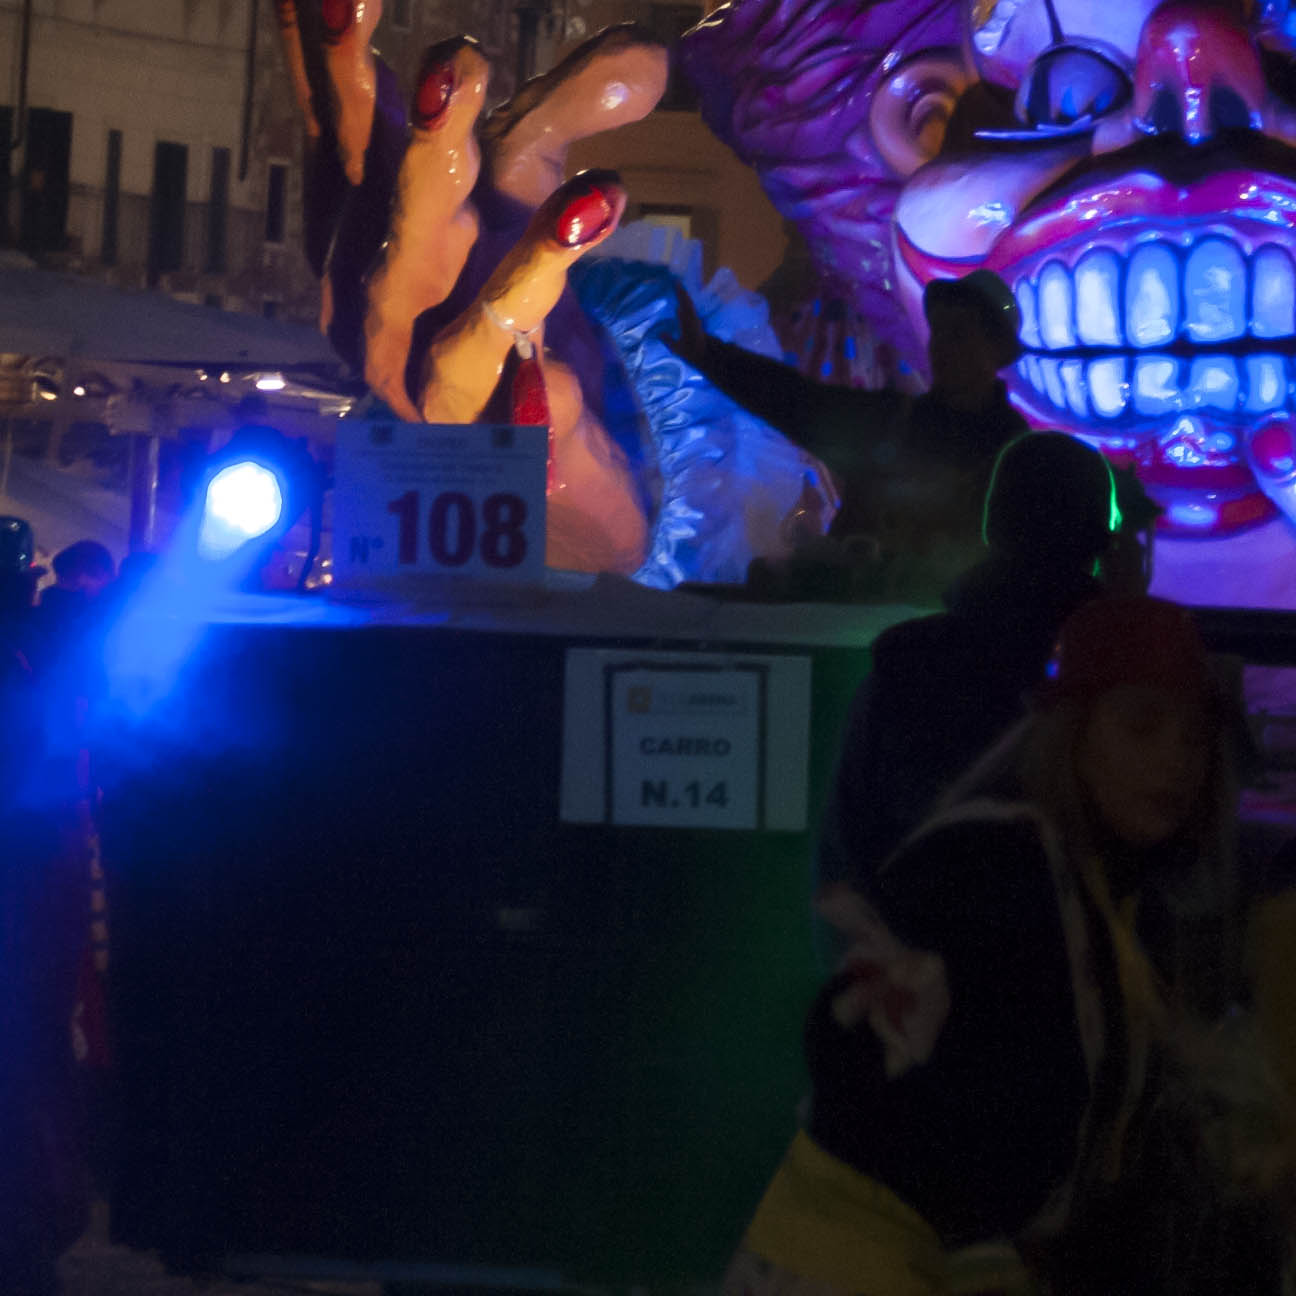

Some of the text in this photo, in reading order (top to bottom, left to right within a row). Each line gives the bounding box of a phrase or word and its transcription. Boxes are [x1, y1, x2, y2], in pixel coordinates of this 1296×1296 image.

[387, 490, 528, 568] 108
[639, 737, 732, 756] CARRO
[641, 780, 729, 808] N.14
